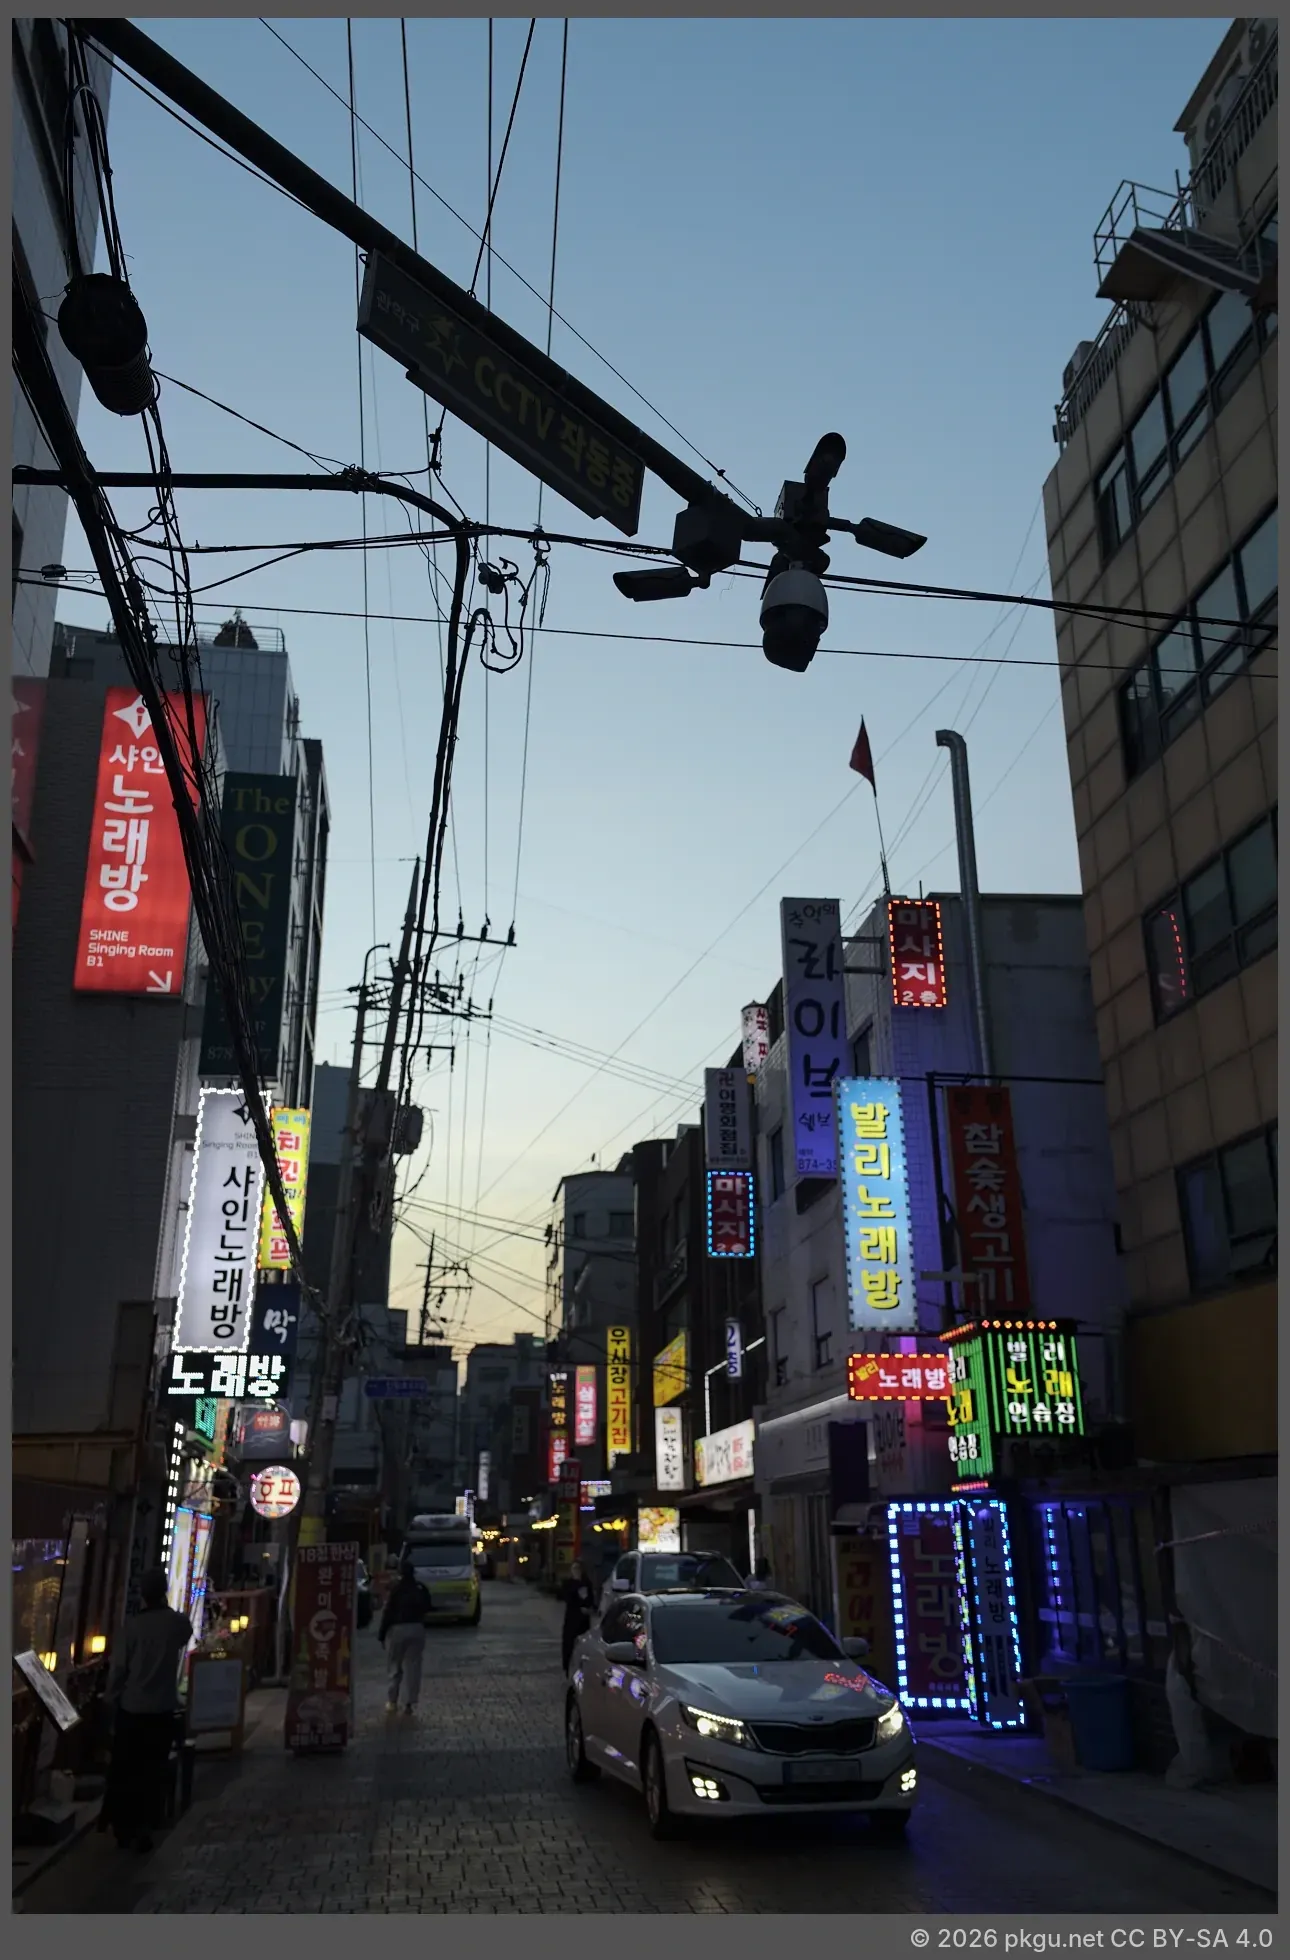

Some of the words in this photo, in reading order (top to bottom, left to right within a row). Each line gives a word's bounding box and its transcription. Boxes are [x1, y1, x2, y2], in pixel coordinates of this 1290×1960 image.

[474, 356, 556, 440] CCTV
[560, 415, 635, 508] 작동중
[108, 744, 165, 774] 샤인
[230, 787, 291, 813] The
[99, 775, 154, 912] 노래방
[788, 904, 836, 929] 추억의
[88, 943, 136, 958] Singing
[138, 945, 174, 957] Room
[89, 930, 129, 943] SHINE
[898, 908, 936, 986] 마사지
[86, 956, 104, 967] B1
[788, 938, 841, 1098] 라이브
[714, 1178, 747, 1239] 마사지
[850, 1102, 902, 1310] 발리노래방
[963, 1121, 1016, 1304] 참숯생고기
[211, 1165, 256, 1339] 샤인노래방
[1006, 1341, 1065, 1363] 발리
[167, 1354, 286, 1398] 노래방
[878, 1366, 946, 1390] 노래방
[1006, 1367, 1074, 1398] 노래
[1008, 1402, 1076, 1425] 연습장
[255, 1475, 294, 1505] 호프
[984, 1555, 1006, 1623] 노래방
[913, 1538, 965, 1678] 노래방
